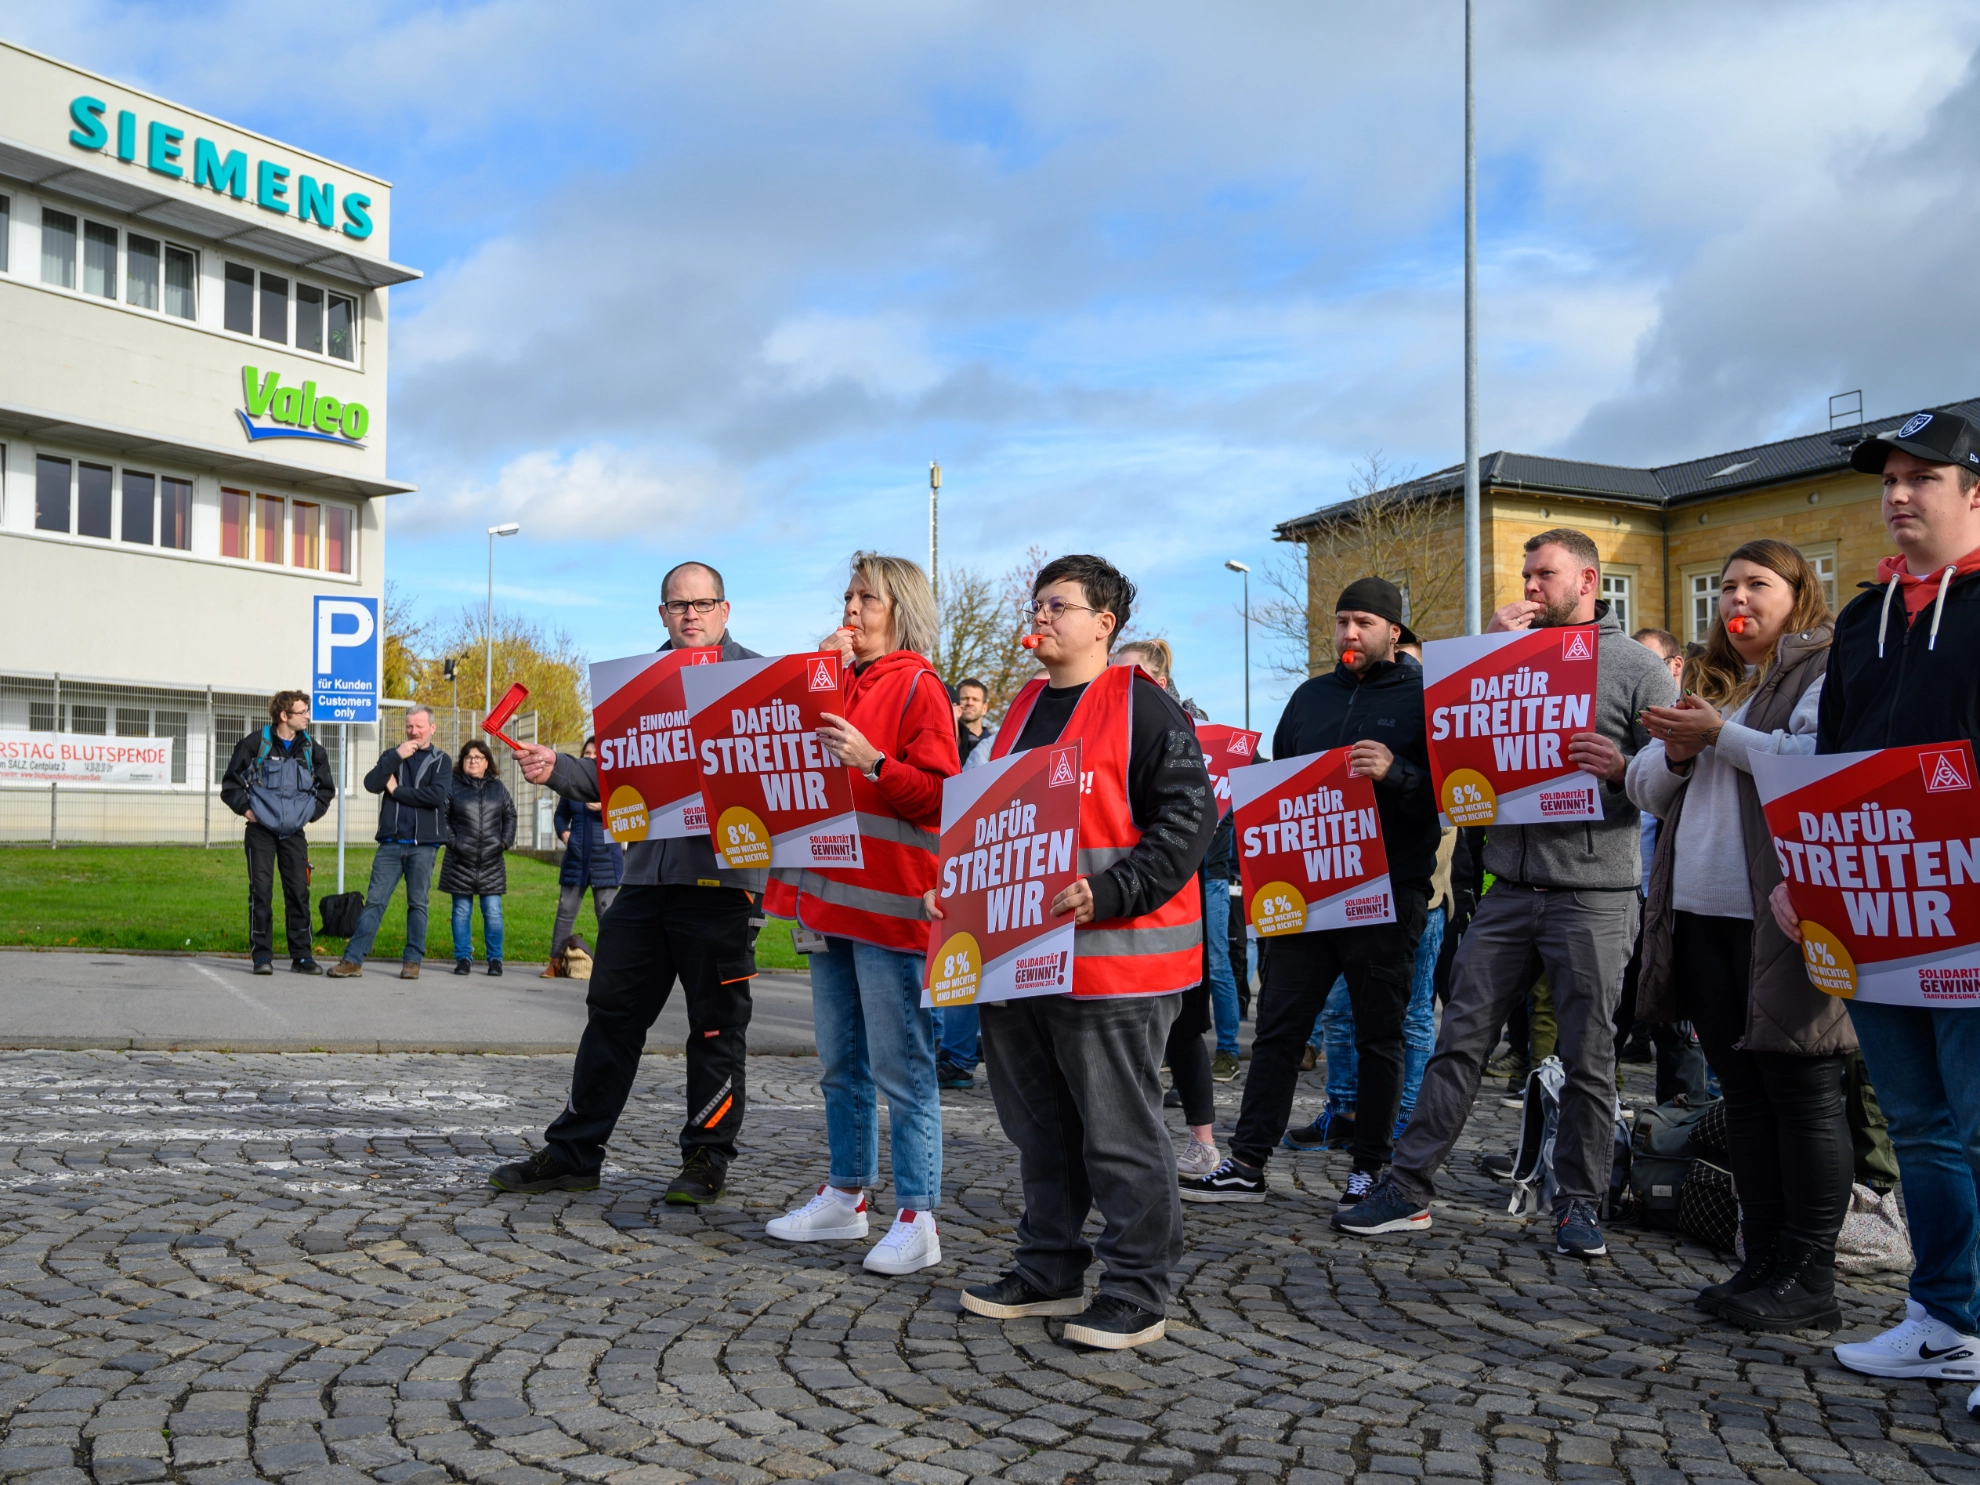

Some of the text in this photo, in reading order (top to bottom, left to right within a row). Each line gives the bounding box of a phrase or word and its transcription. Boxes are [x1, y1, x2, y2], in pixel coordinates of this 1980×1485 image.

[69, 96, 374, 240] SIEMENS
[242, 364, 370, 439] Valeo
[317, 599, 375, 675] P
[318, 679, 372, 691] für Kunden
[1470, 666, 1549, 702] DAFÜR
[318, 695, 372, 707] Customers
[334, 707, 356, 720] only
[731, 698, 802, 735] DAFÜR
[1431, 694, 1591, 741] STREITEN
[61, 744, 165, 764] BLUTSPENDE
[1492, 732, 1563, 772] WIR
[30, 760, 60, 771] Centplatz
[61, 762, 66, 771] 2
[759, 771, 829, 811] WIR
[1539, 788, 1586, 801] SOLIDARITÄT
[683, 806, 706, 816] SOLIDA
[1279, 786, 1345, 821] DAFÜR
[1449, 801, 1492, 815] SIND WICHTIG
[612, 816, 630, 833] FÜR
[974, 798, 1037, 848] DAFÜR
[1453, 810, 1493, 823] UND RICHTIG
[1797, 801, 1915, 843] DAFÜR
[809, 834, 849, 844] SOLIDARITÄT
[1244, 806, 1377, 858] STREITEN
[725, 842, 767, 856] SIND WICHTIG
[730, 851, 769, 865] UND RICHTIG
[940, 828, 1074, 899] STREITEN
[1302, 844, 1365, 883] WIR
[1773, 836, 1980, 890] STREITEN
[986, 880, 1045, 934] WIR
[1344, 895, 1382, 908] SOLIDARITÄT
[1258, 910, 1302, 927] SIND WICHTIG
[1841, 890, 1956, 938] WIR
[1262, 918, 1303, 934] UND RICHTIG
[1015, 952, 1059, 970] SOLIDARITÄT
[1817, 966, 1850, 979] WICHTIG
[935, 973, 977, 992] SIND WICHTIG
[1821, 978, 1853, 990] RICHTIG
[936, 984, 976, 1002] UND RICHTIG
